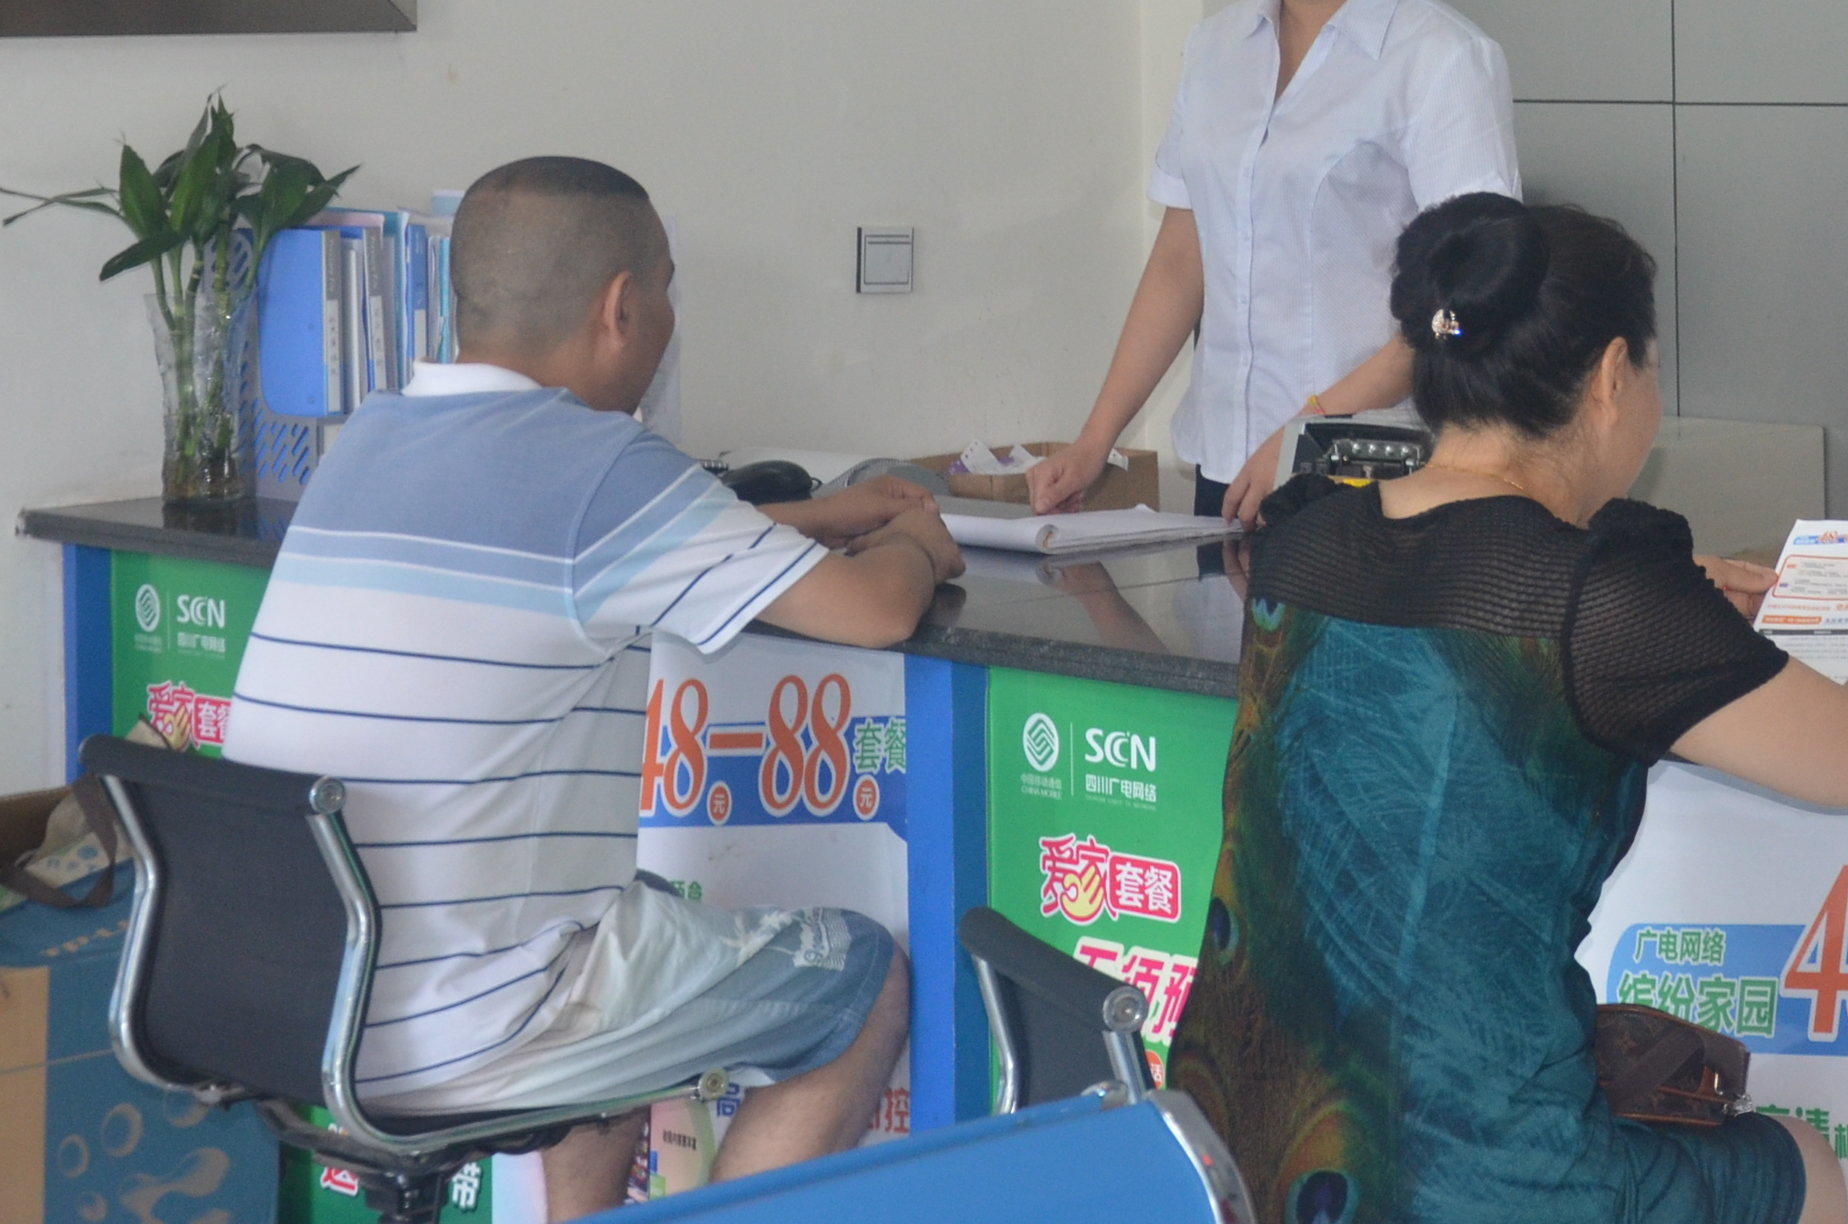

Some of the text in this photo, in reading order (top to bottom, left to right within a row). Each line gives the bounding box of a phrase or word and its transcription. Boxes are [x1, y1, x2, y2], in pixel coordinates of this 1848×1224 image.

[1085, 773, 1156, 803] 四川广电网络
[1634, 928, 1726, 964] 广电网络
